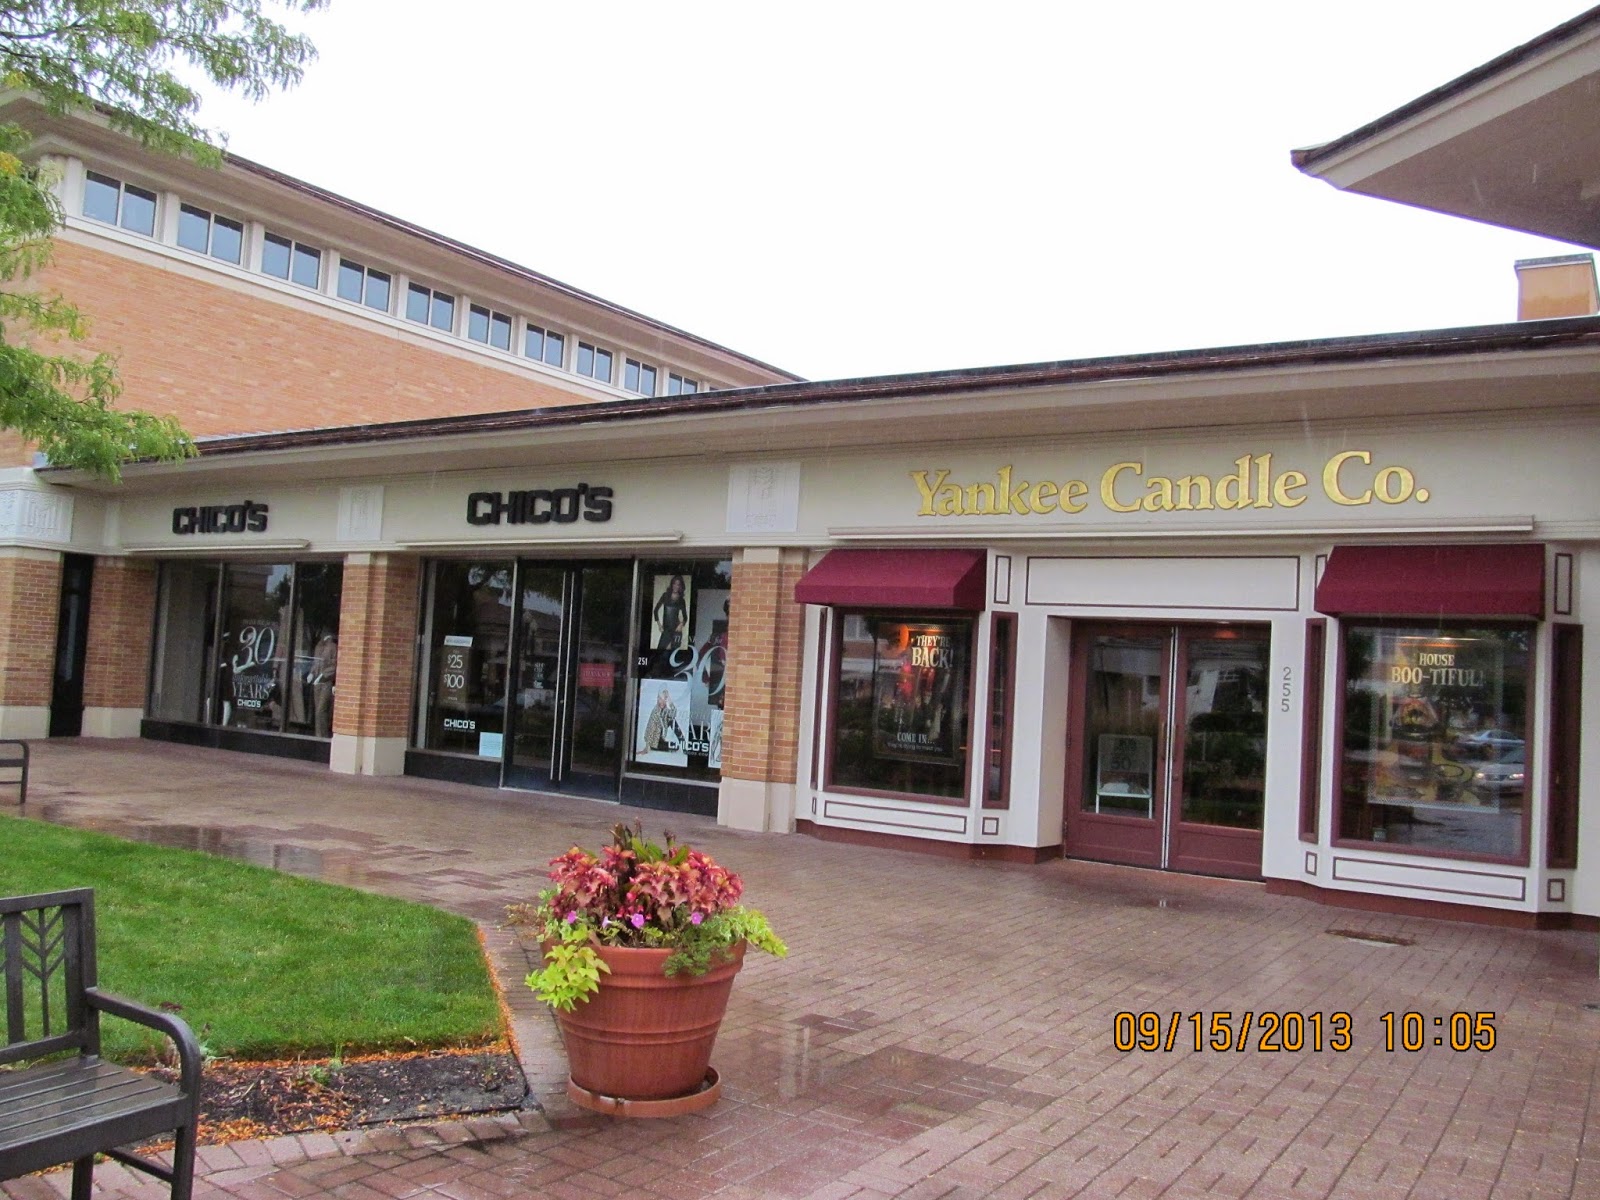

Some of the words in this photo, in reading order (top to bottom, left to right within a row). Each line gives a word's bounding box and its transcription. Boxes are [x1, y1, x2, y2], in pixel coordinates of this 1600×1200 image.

[909, 464, 1088, 516] Yankee
[1100, 452, 1307, 513] Candle
[1322, 450, 1430, 506] Co.
[466, 483, 613, 526] CHICO'S
[172, 500, 269, 535] CHICO'S
[916, 635, 951, 647] THEY'RE
[233, 626, 275, 673] 30
[447, 654, 463, 669] $25
[637, 657, 648, 666] 251
[912, 647, 954, 669] BACK!
[1419, 653, 1455, 666] HOUSE
[444, 673, 465, 689] $100
[1391, 666, 1485, 687] BOO-TIFUL!
[1281, 666, 1291, 712] 255
[237, 698, 261, 708] CHICO'S
[444, 718, 476, 730] CHICO'S
[897, 732, 917, 743] COME
